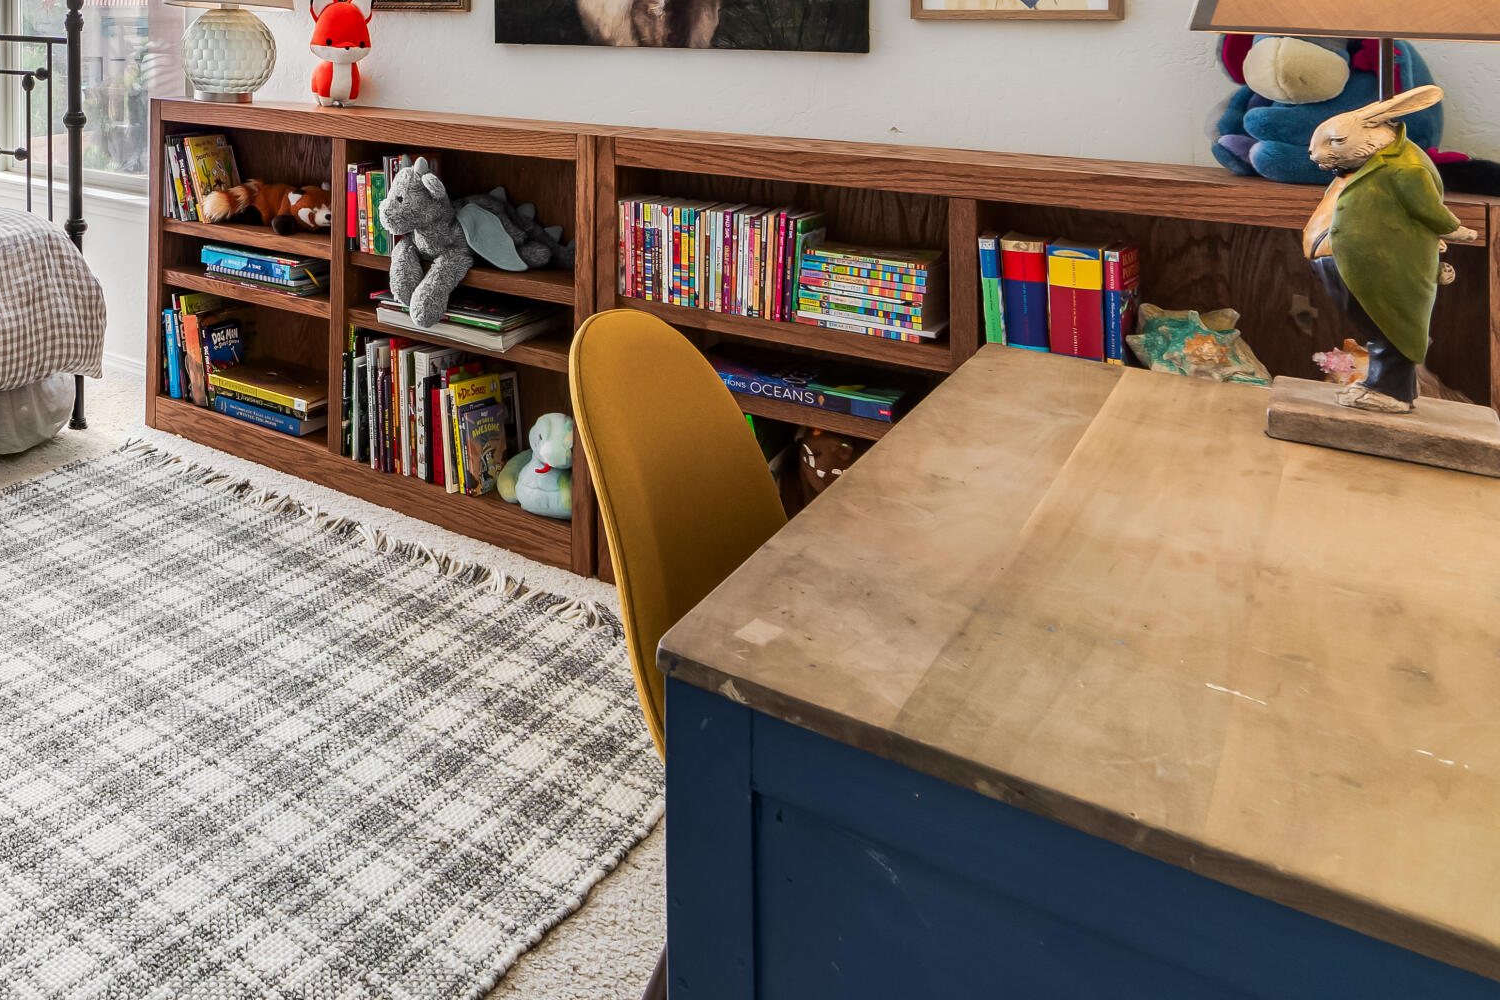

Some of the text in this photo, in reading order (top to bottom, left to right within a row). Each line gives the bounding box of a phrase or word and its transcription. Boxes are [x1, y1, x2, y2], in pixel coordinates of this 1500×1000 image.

[211, 328, 239, 344] DOG MAN
[471, 384, 486, 396] Seuss
[750, 381, 814, 404] OCEANS
